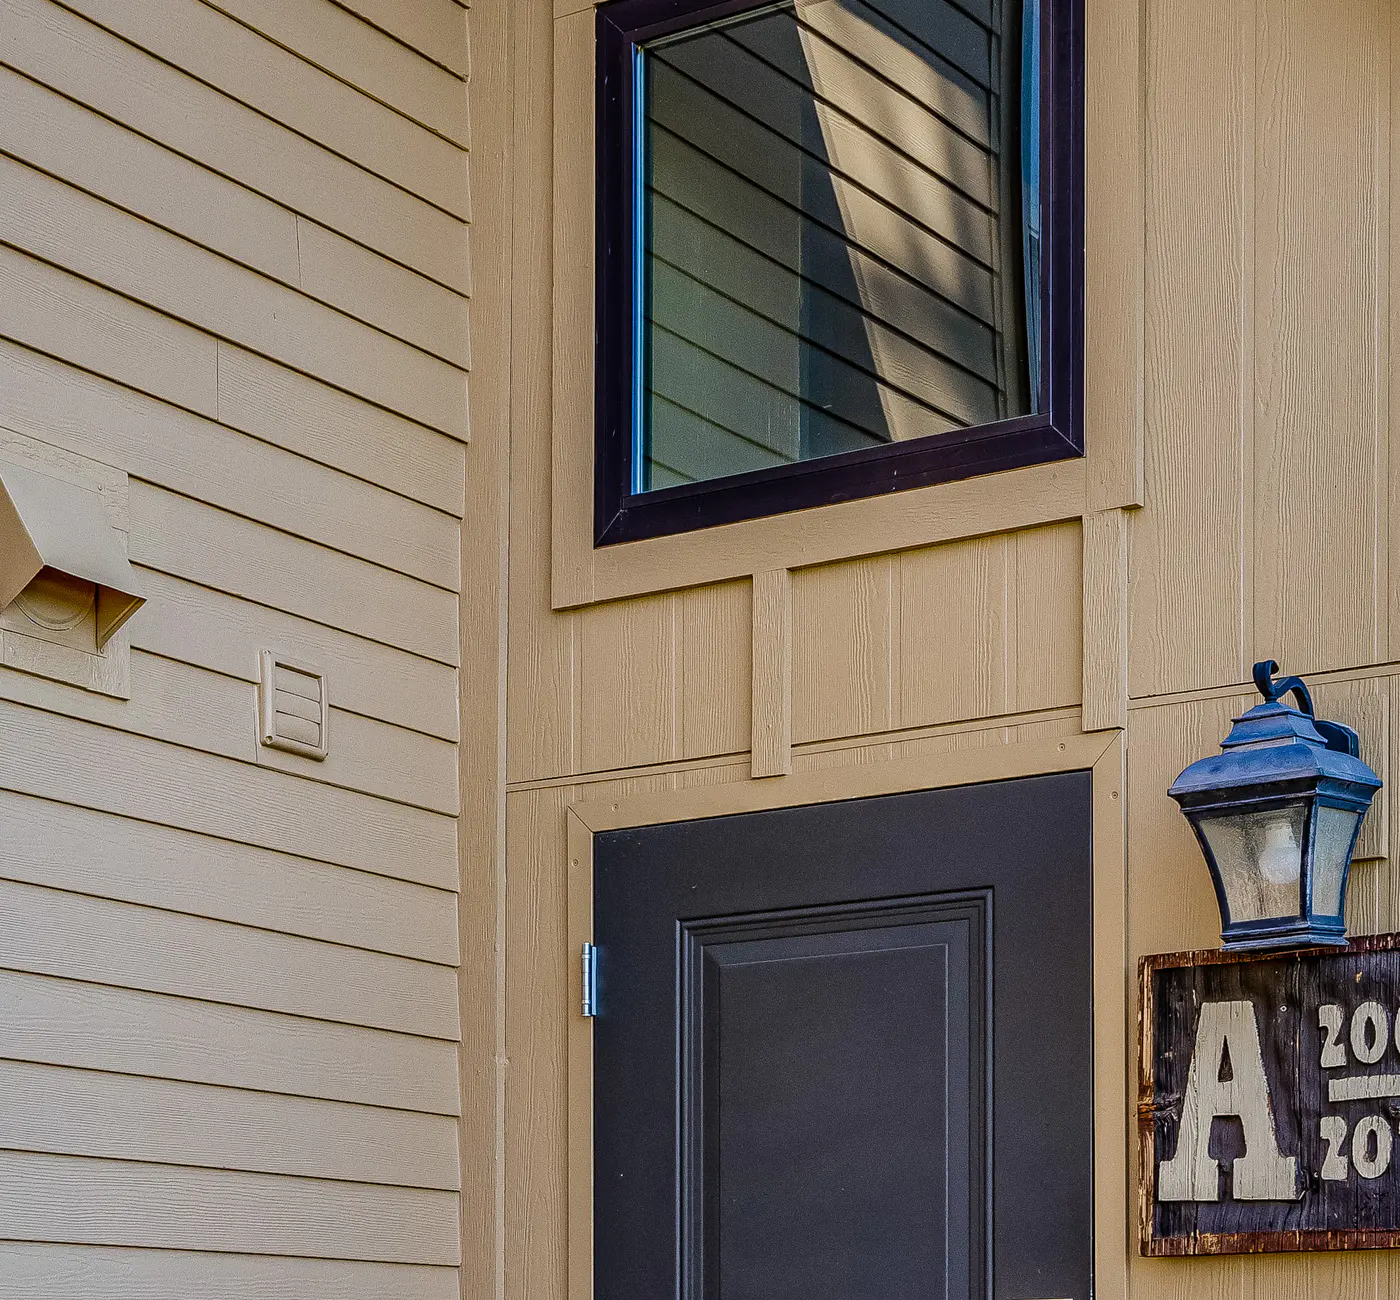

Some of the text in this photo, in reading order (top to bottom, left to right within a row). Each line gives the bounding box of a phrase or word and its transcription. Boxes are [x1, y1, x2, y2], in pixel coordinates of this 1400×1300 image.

[1318, 1001, 1400, 1068] 20
[1159, 1001, 1296, 1200] A
[1320, 1115, 1400, 1180] 20
